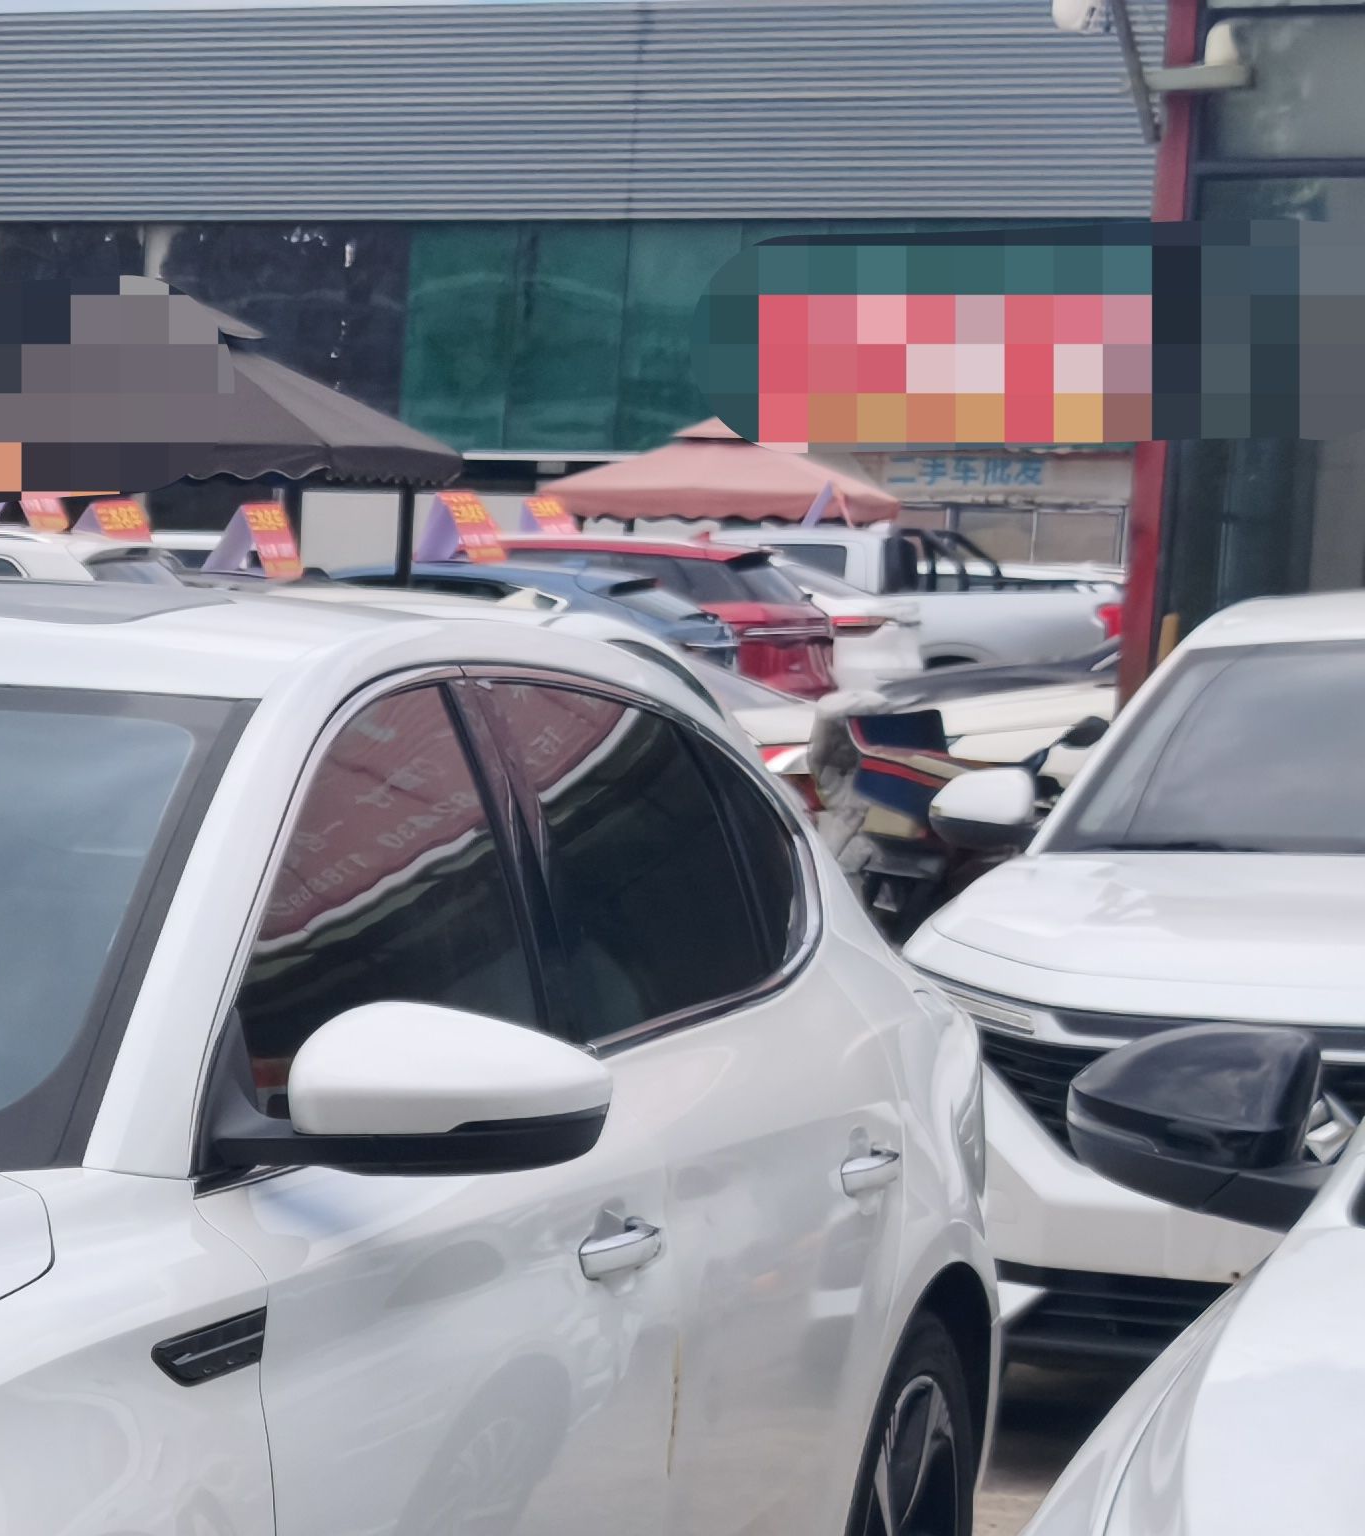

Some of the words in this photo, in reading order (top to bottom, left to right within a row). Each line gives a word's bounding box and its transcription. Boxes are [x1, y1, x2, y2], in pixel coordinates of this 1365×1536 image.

[887, 456, 1045, 486] 二手车批发
